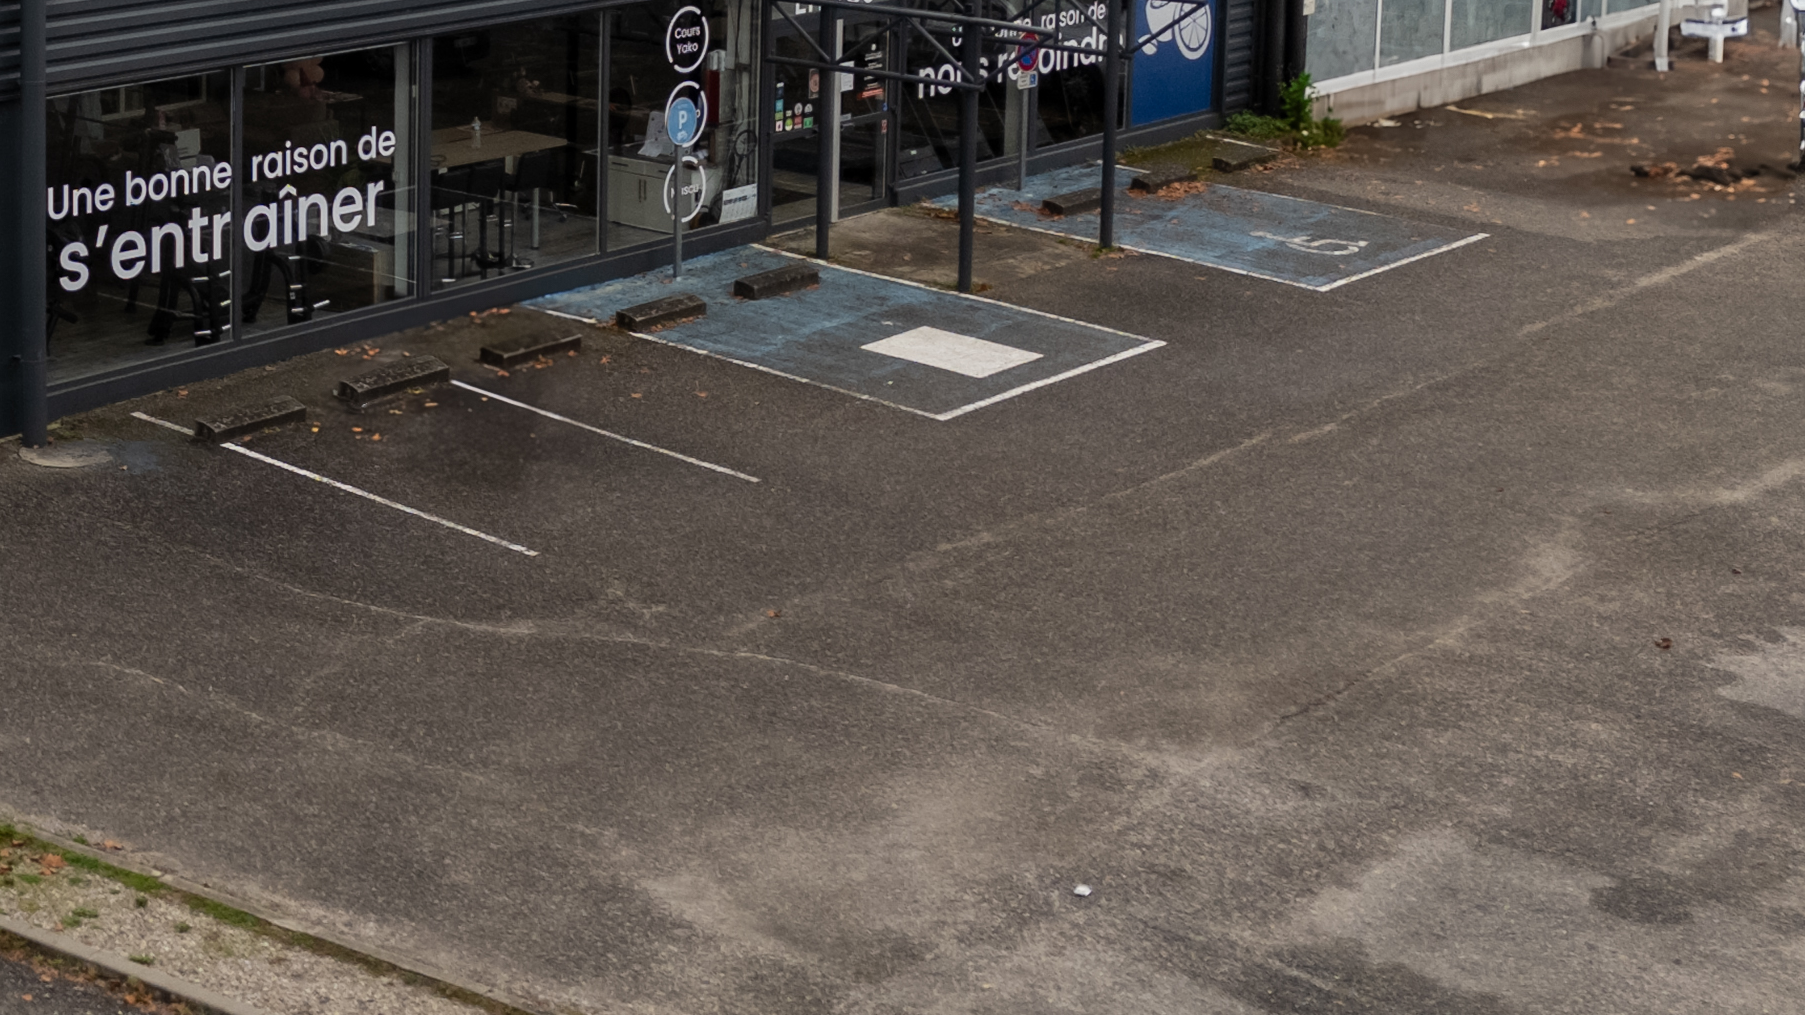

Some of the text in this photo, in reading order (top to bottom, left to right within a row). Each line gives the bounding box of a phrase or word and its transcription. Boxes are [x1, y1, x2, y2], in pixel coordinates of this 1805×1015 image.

[1040, 9, 1085, 29] rason
[674, 26, 701, 39] Cours
[997, 26, 1124, 84] reoindr
[678, 110, 688, 130] P
[47, 125, 397, 220] Une bonne raison de
